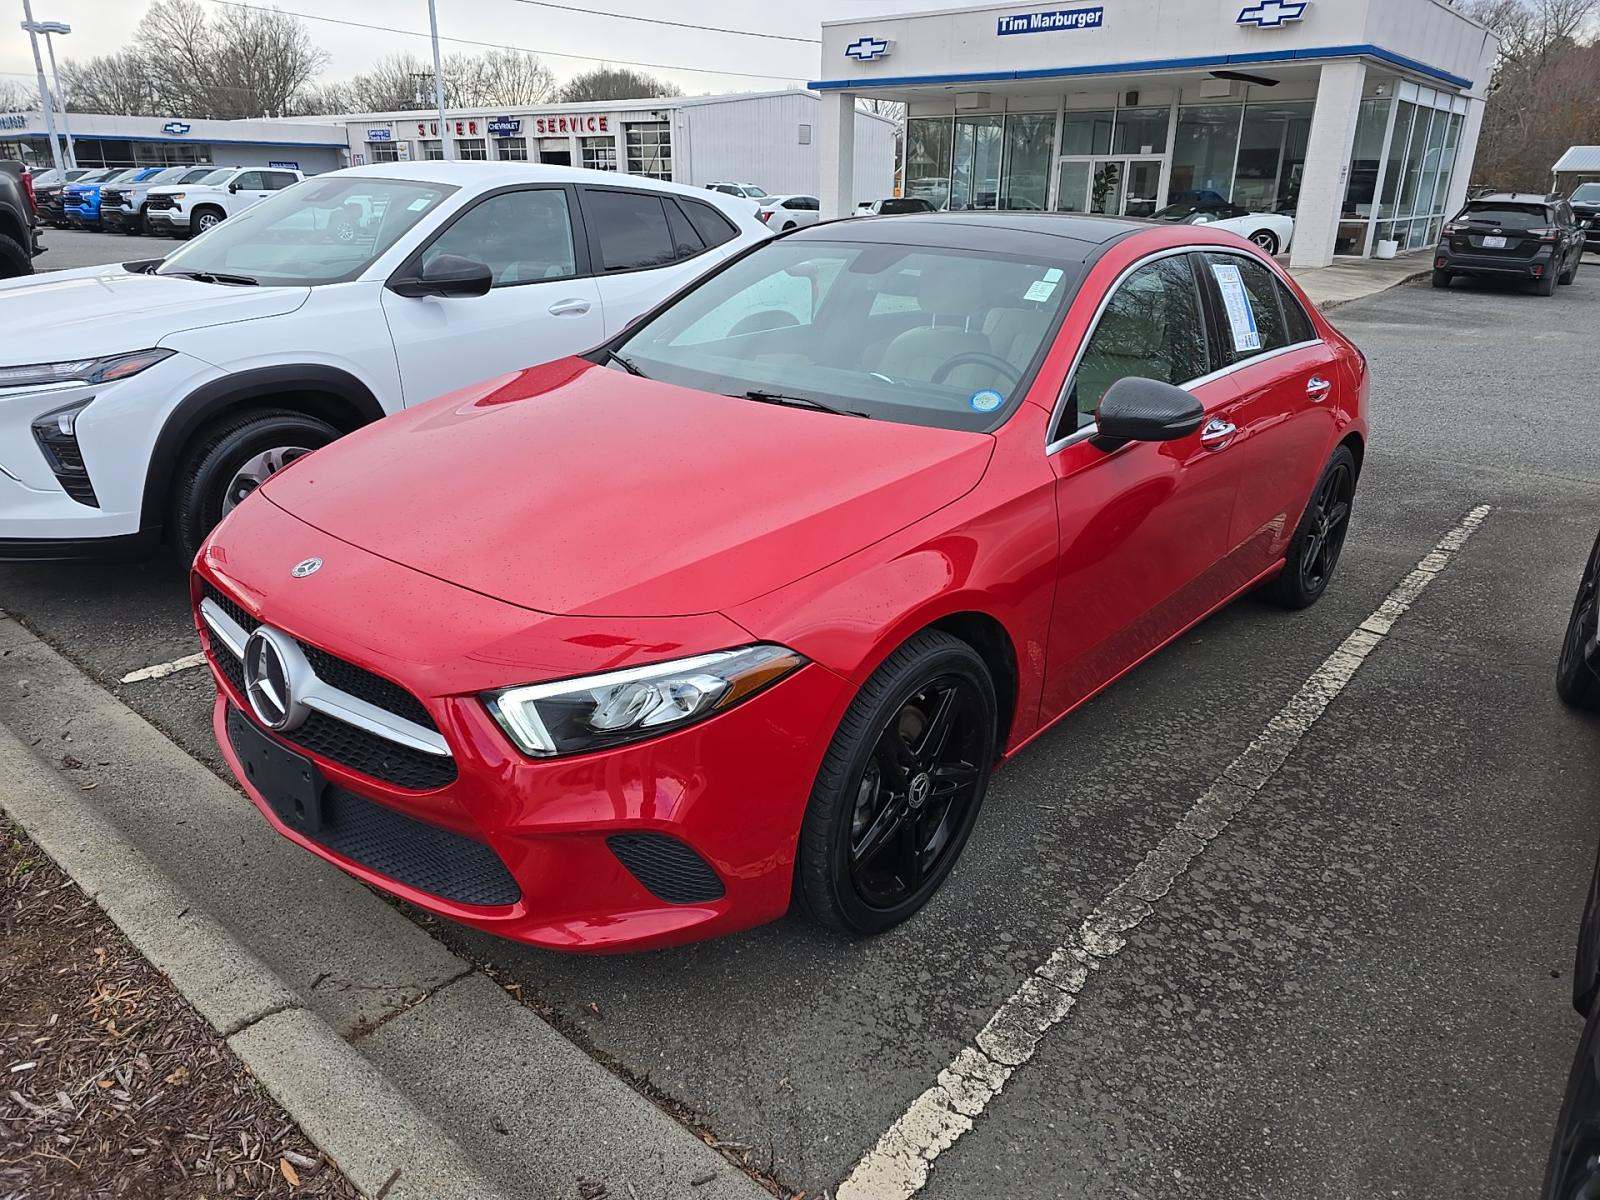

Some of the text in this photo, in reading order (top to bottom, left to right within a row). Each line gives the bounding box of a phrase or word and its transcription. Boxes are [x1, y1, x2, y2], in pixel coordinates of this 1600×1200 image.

[1000, 11, 1102, 31] Tim Marburger
[488, 121, 518, 131] CHEVROLET
[536, 115, 608, 134] SERVICE
